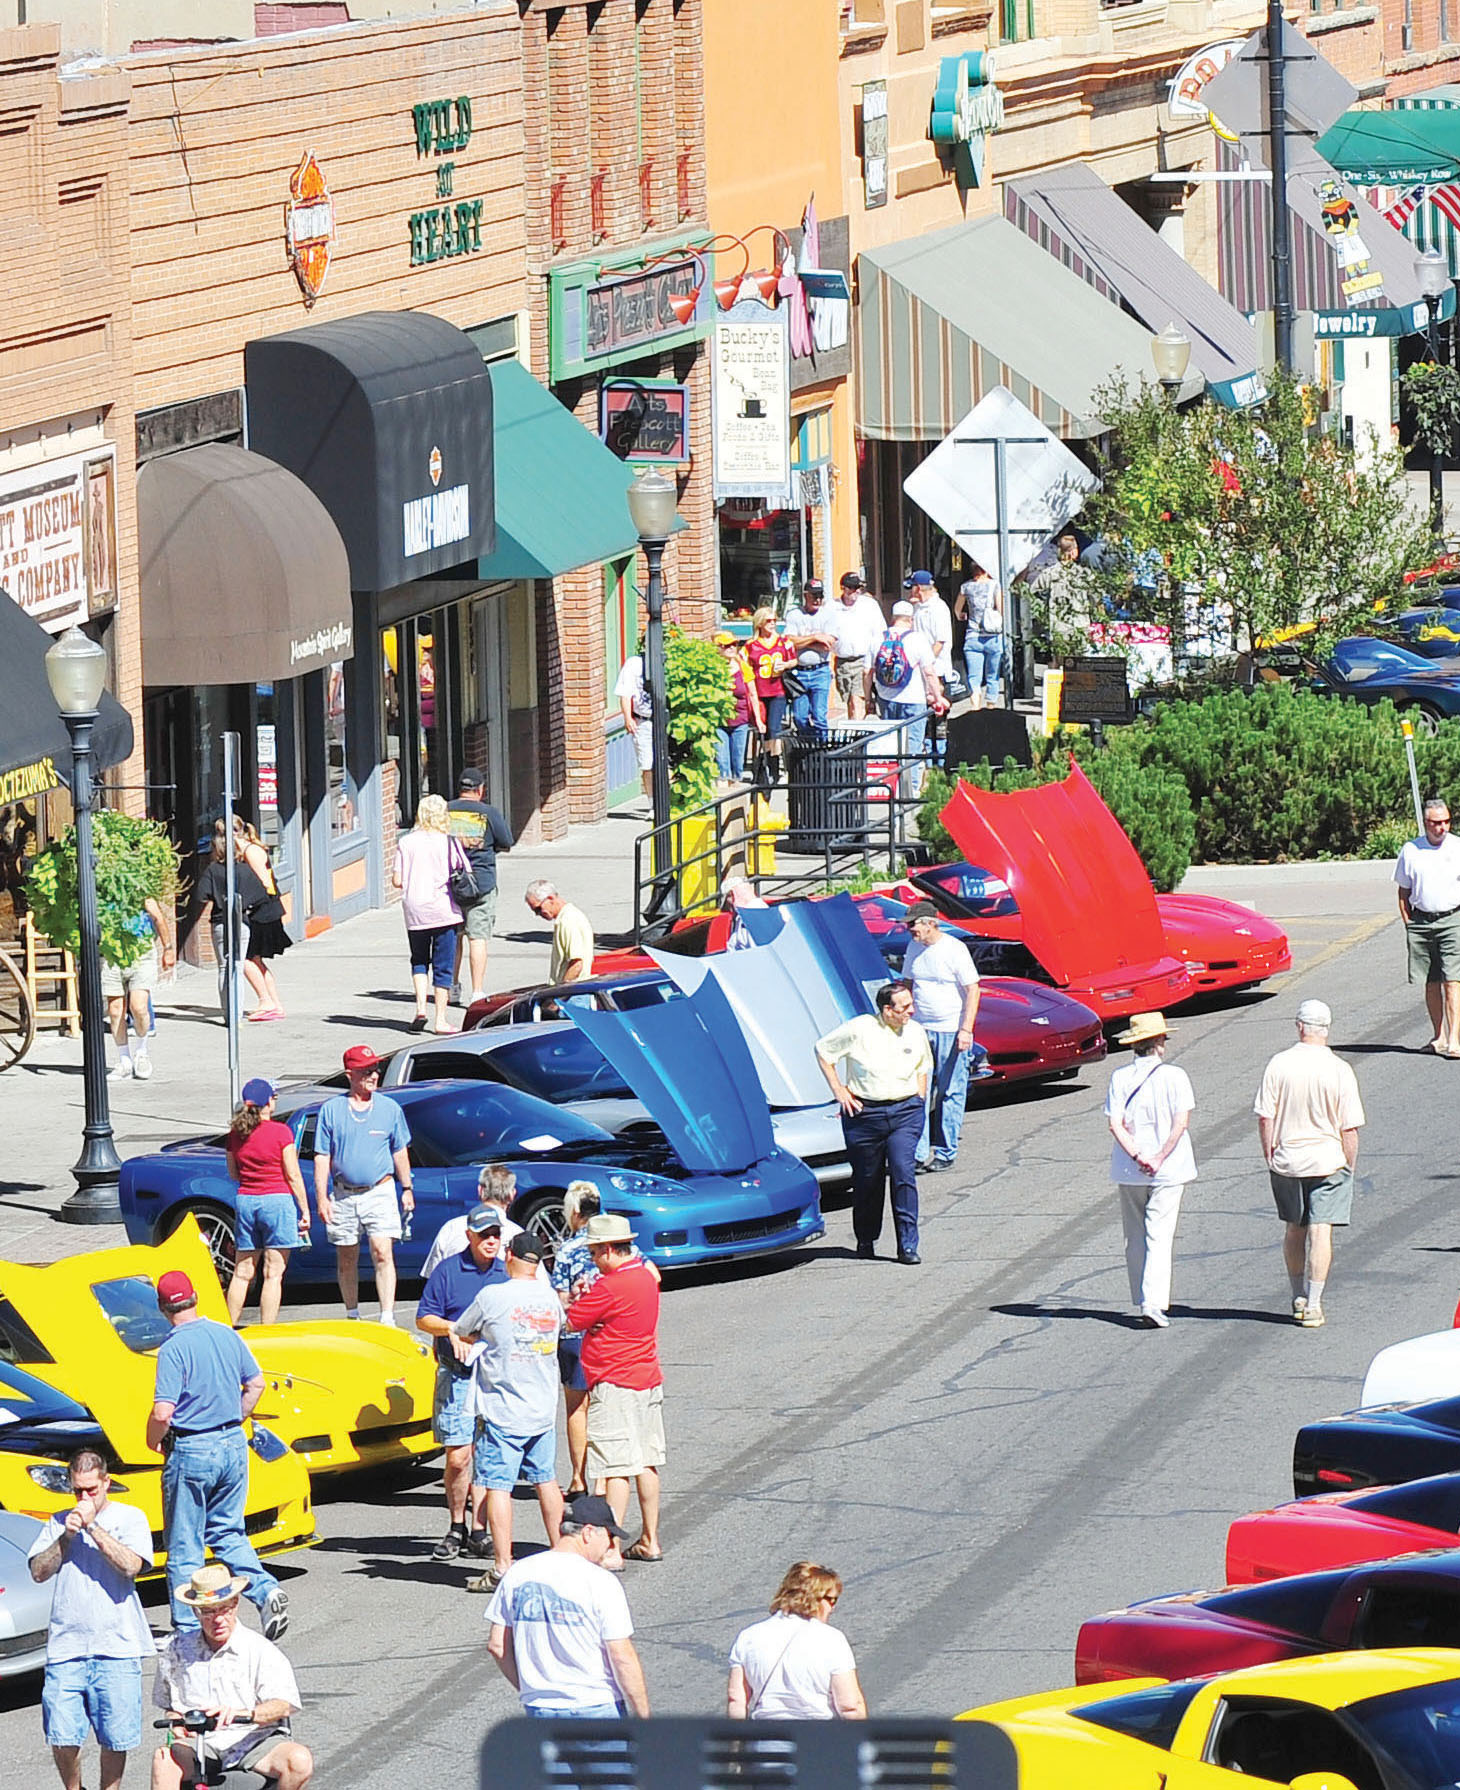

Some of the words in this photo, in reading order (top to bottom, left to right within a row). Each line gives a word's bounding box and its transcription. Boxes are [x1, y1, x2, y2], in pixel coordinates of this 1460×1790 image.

[412, 96, 472, 153] WILD
[436, 162, 454, 194] AT
[1389, 168, 1428, 182] Whiskey
[410, 199, 484, 265] HEART
[720, 328, 780, 350] Bucky's
[721, 349, 780, 363] Gourmet
[22, 490, 81, 544] MUSEUM
[3, 548, 28, 569] AND
[18, 552, 80, 609] COMPANY
